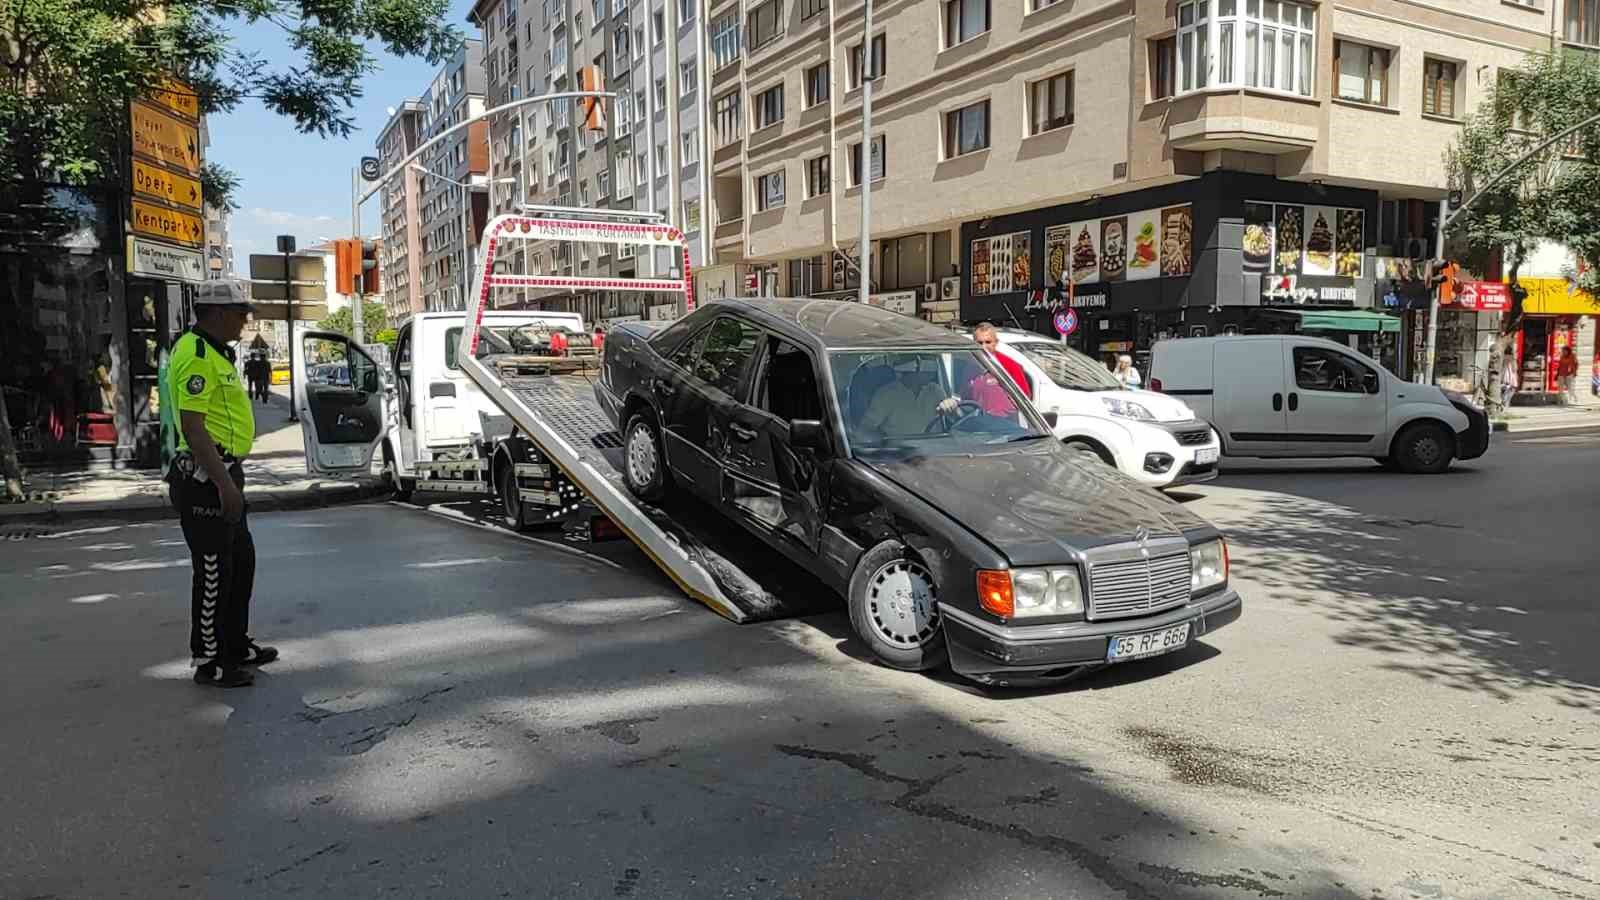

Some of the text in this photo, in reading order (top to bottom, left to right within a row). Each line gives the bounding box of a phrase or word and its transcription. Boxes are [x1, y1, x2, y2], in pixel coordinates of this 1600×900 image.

[136, 168, 173, 194] Opera
[135, 207, 188, 233] Kentpark
[1070, 291, 1106, 307] URUYEMİŞ
[1117, 626, 1186, 655] 55 RF 666
